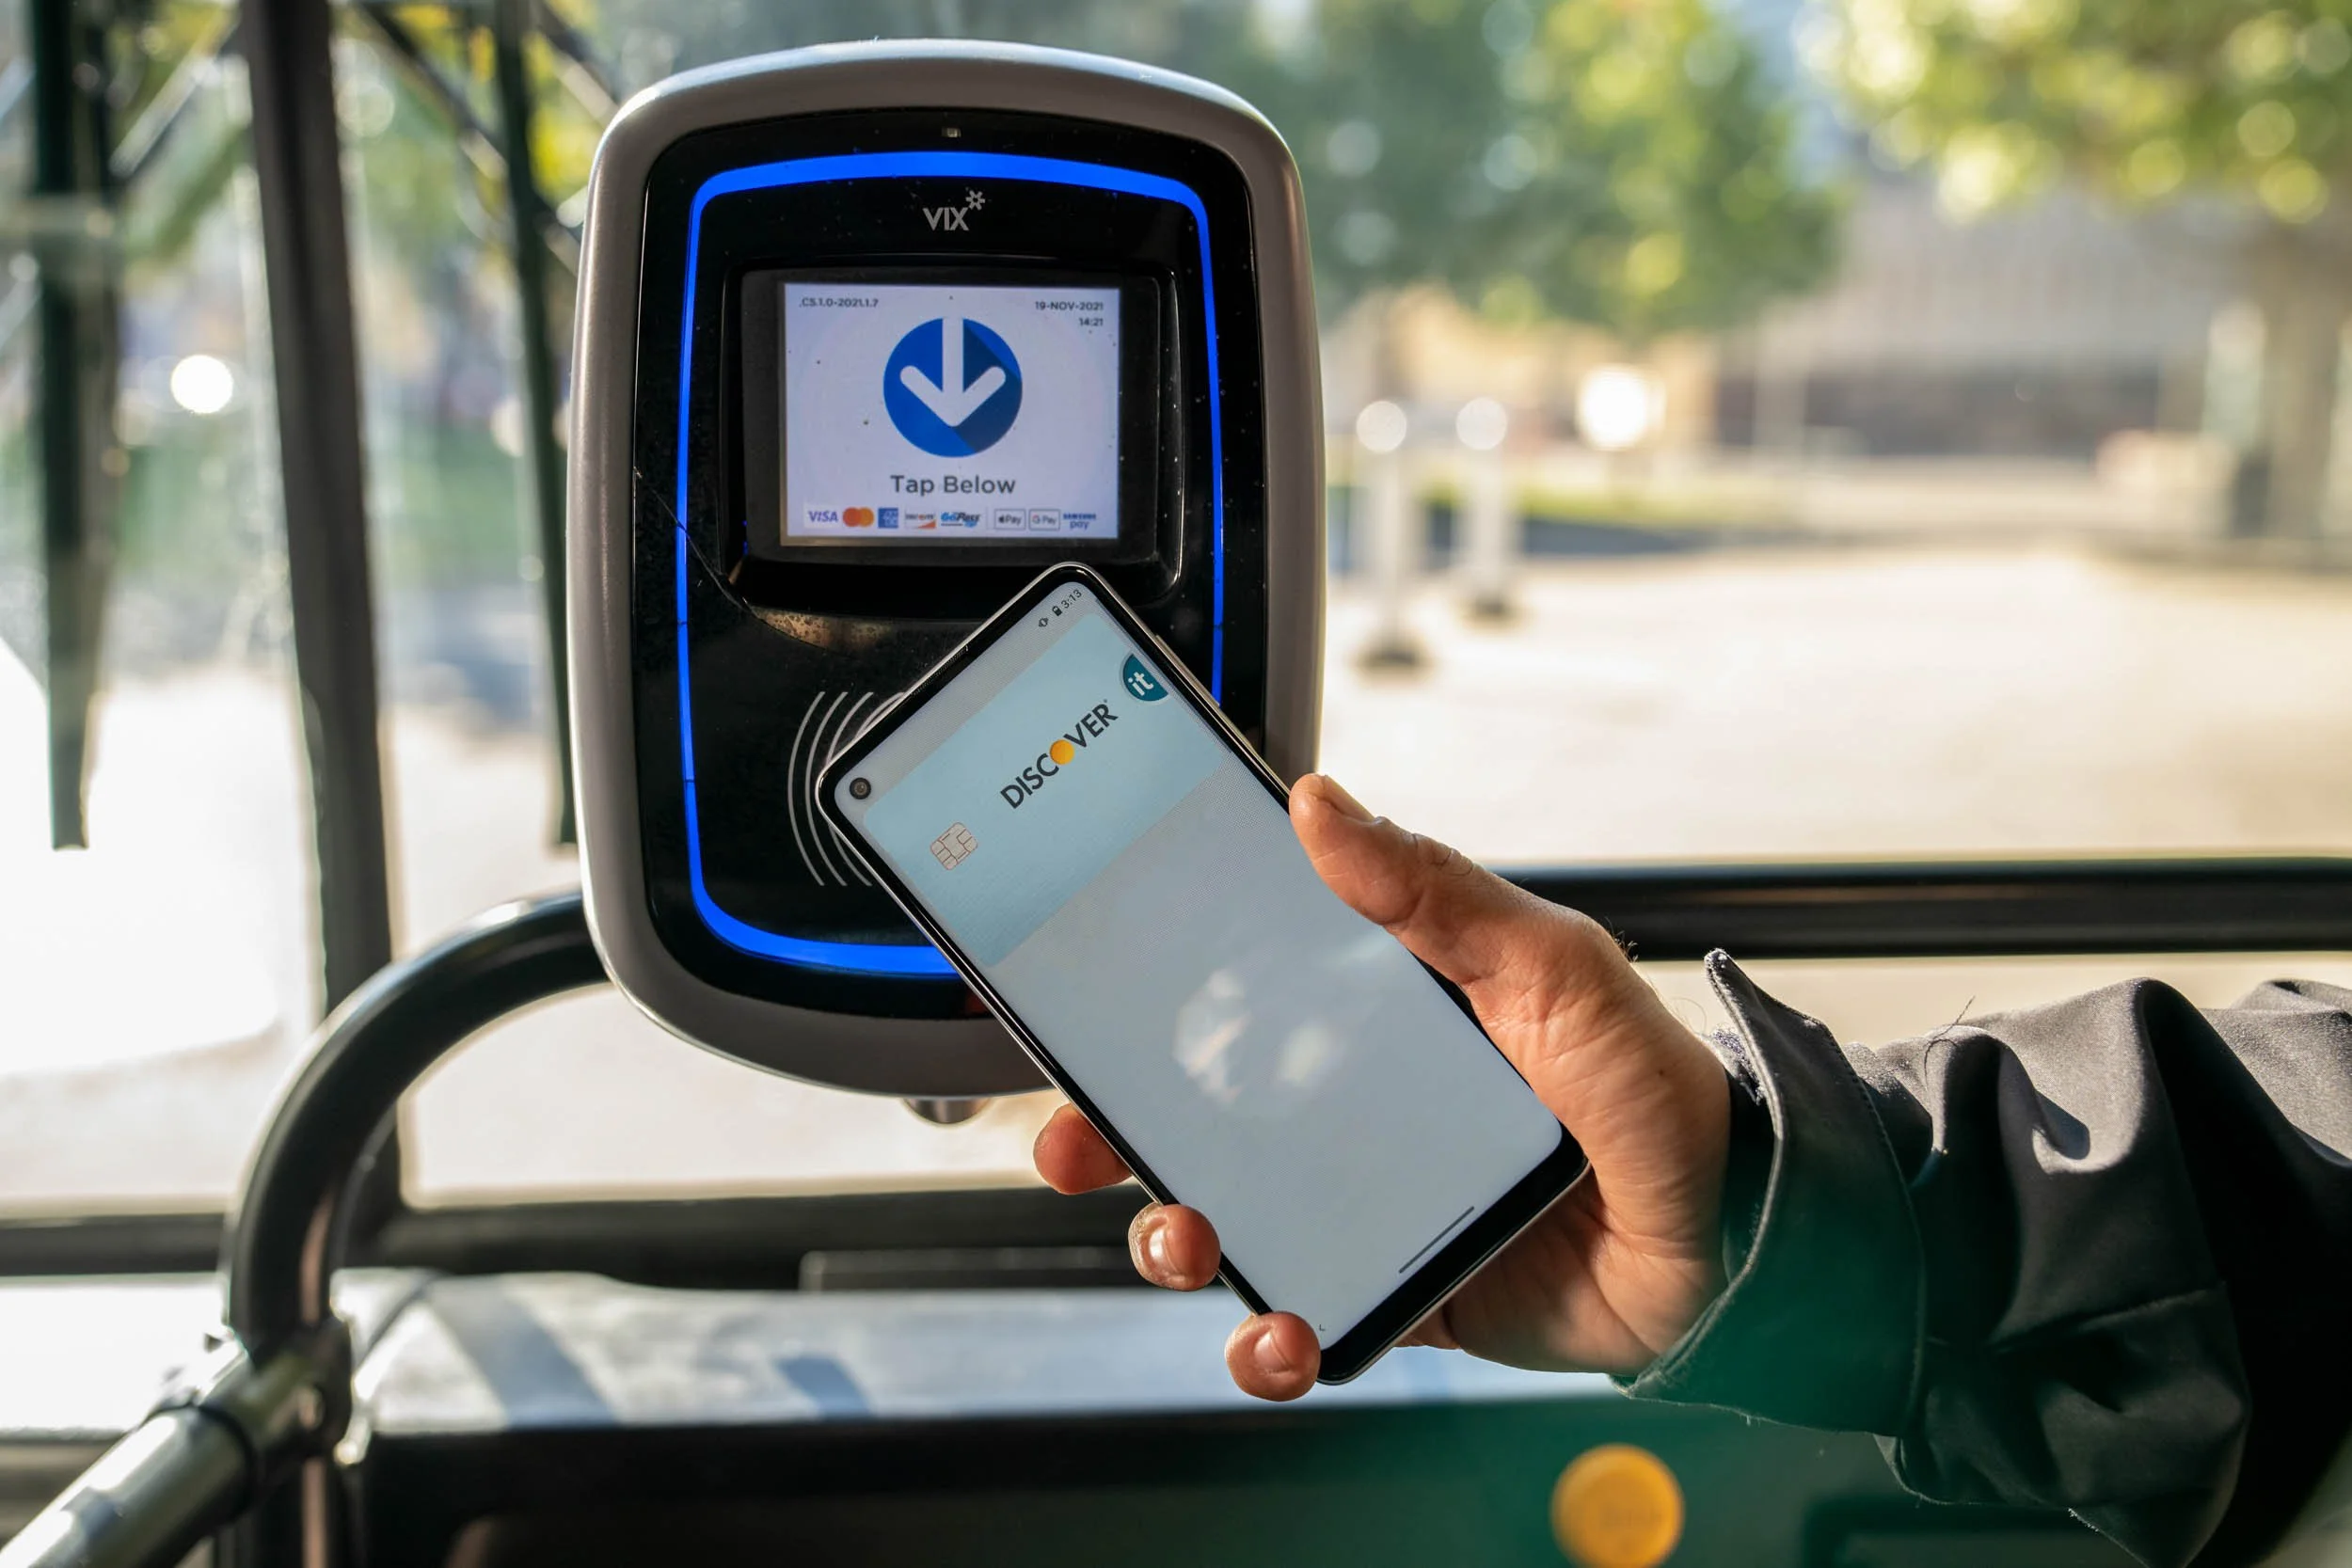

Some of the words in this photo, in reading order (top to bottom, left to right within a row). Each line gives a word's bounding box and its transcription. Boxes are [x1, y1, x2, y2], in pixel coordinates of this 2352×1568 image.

[922, 207, 969, 231] VIX
[1035, 301, 1104, 311] 19-NOV-2021
[1078, 317, 1104, 326] 14:21
[890, 475, 935, 497] Tap
[944, 474, 1016, 495] Below
[808, 510, 839, 523] VISA
[1005, 515, 1022, 526] Pay
[1070, 520, 1090, 531] pay
[1060, 589, 1082, 609] 3:13
[1127, 671, 1154, 697] it
[999, 702, 1119, 810] DISCOVER
